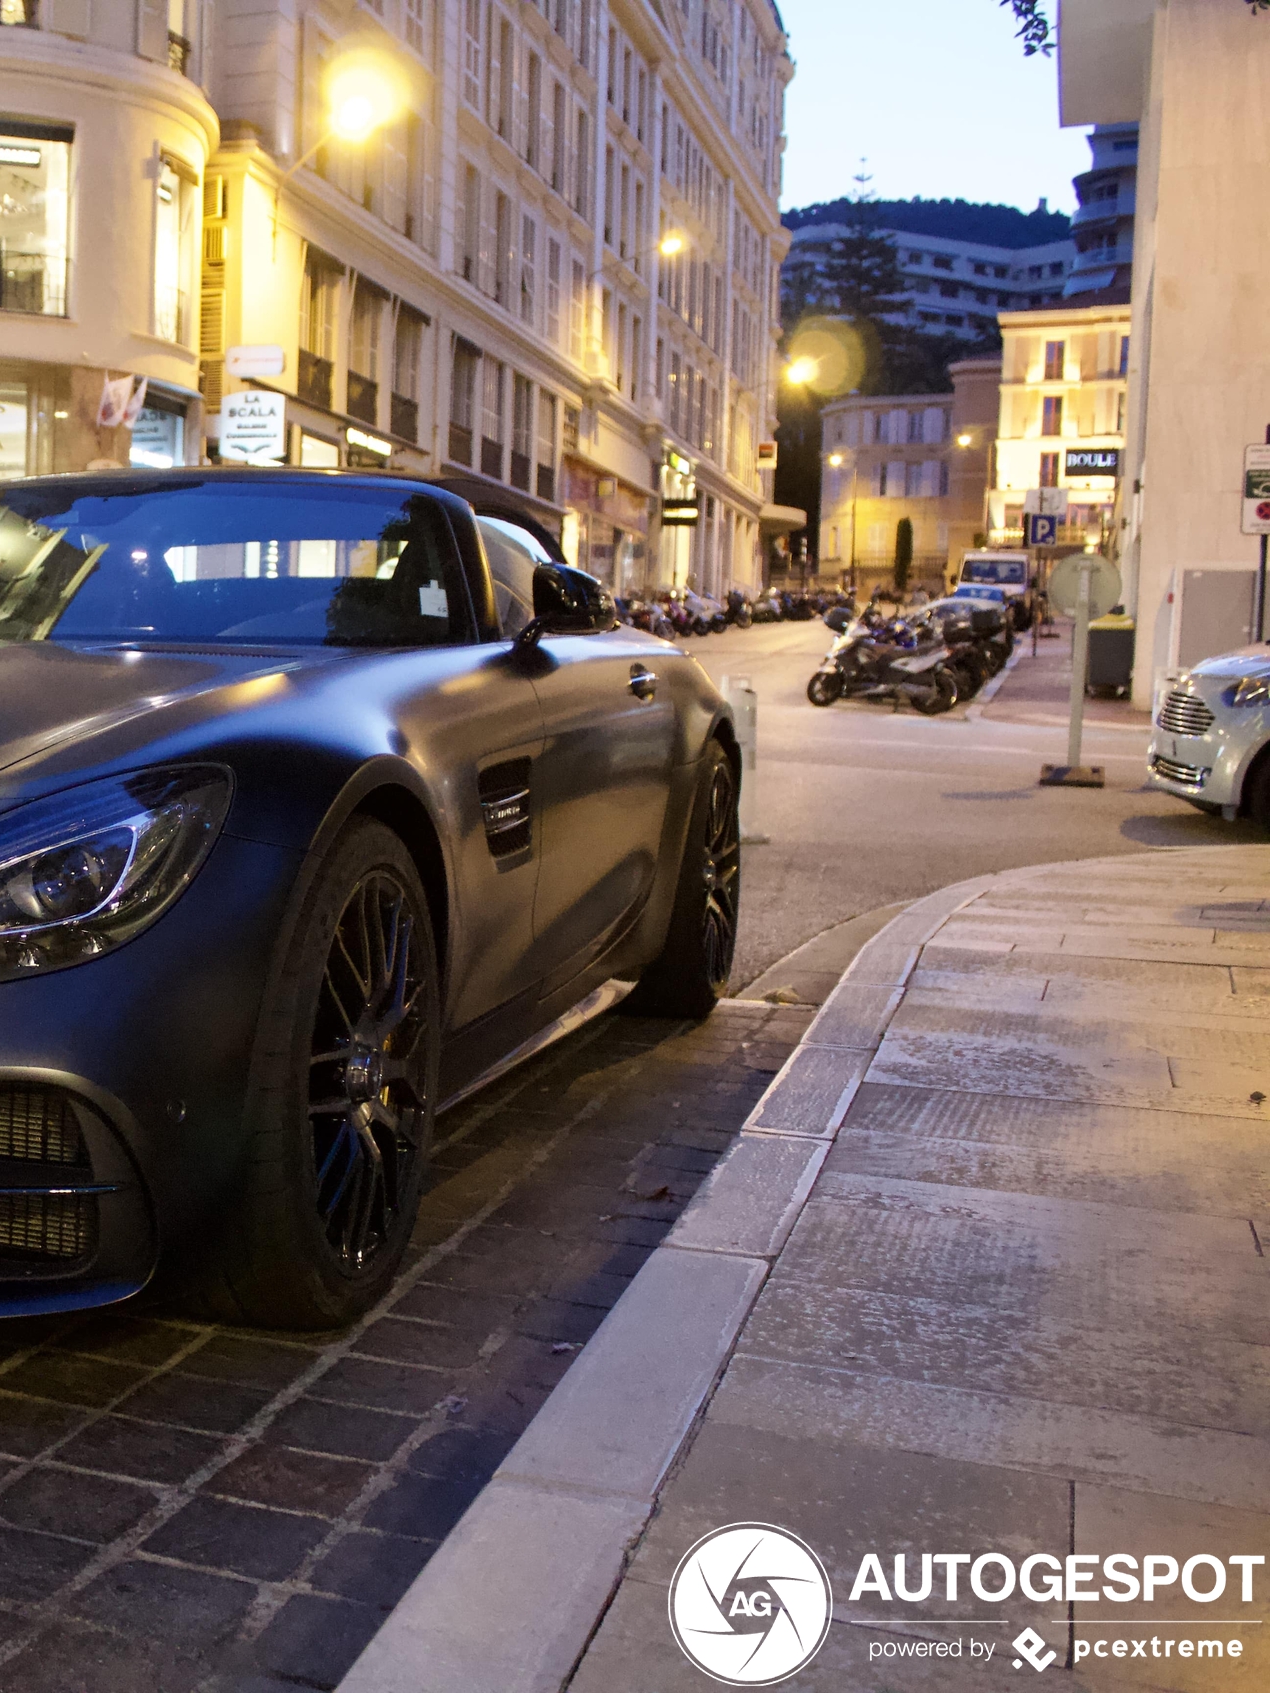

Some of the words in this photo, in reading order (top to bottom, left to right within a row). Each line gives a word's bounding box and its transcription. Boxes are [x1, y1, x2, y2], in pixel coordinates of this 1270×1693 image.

[244, 394, 260, 403] LA
[228, 406, 277, 417] SCALA
[1067, 453, 1117, 467] BOULE
[1037, 520, 1051, 541] P
